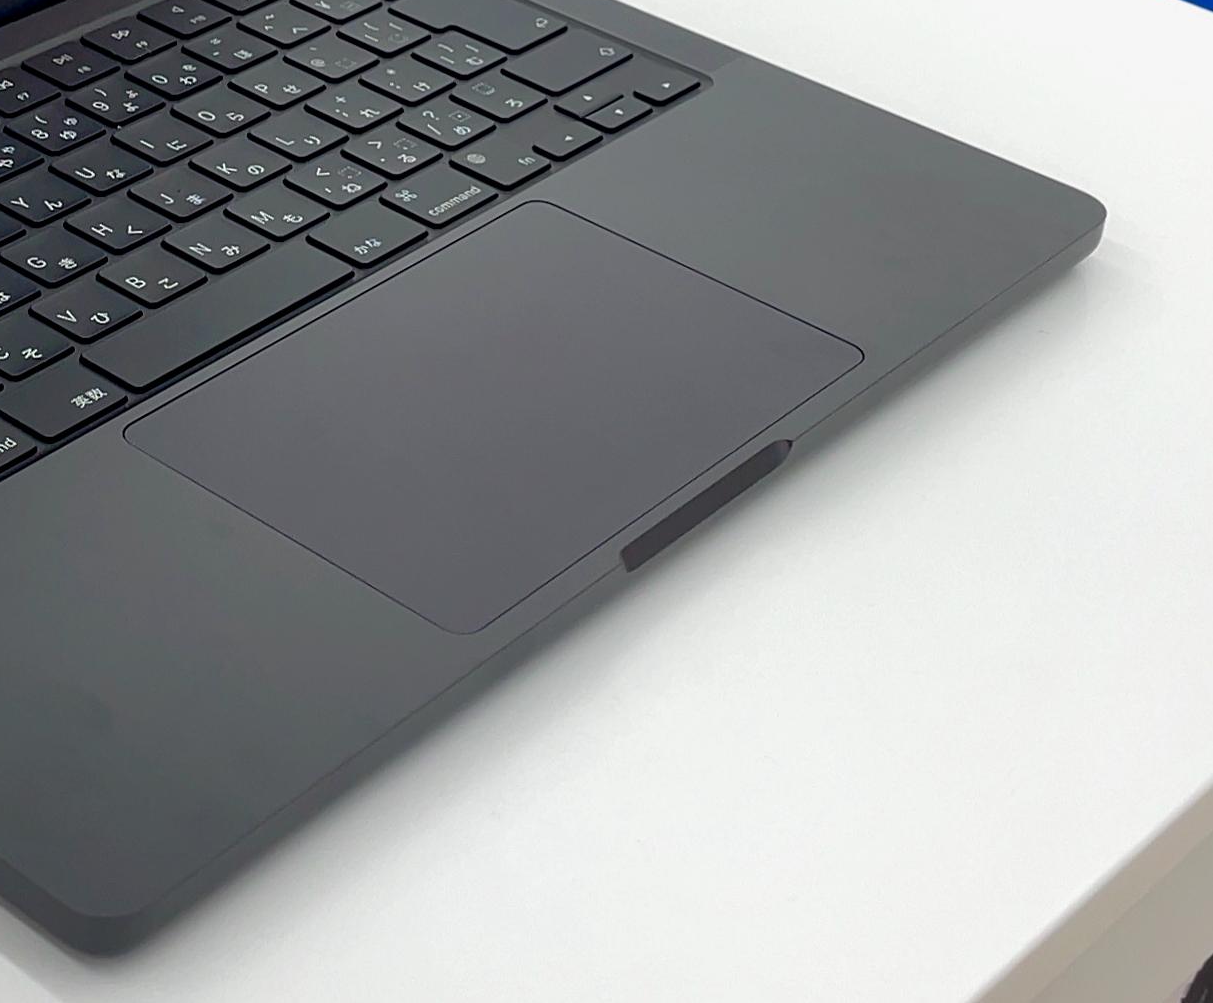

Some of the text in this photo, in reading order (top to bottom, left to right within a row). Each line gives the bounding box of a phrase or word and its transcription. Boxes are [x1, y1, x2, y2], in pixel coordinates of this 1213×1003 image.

[92, 101, 110, 112] 9
[31, 129, 49, 140] 8
[166, 139, 187, 151] に
[275, 136, 295, 146] L
[75, 167, 96, 179] U
[217, 163, 238, 175] K
[247, 164, 265, 175] の
[11, 197, 30, 209] Y
[160, 193, 175, 205] J
[428, 185, 482, 217] command
[44, 200, 63, 211] ん
[251, 211, 275, 225] M
[282, 213, 304, 223] も
[91, 223, 113, 237] H
[127, 225, 143, 236] く
[189, 242, 212, 256] N
[27, 257, 47, 269] G
[125, 276, 146, 289] B
[56, 309, 77, 323] V
[90, 312, 110, 324] ひ
[21, 348, 43, 359] そ
